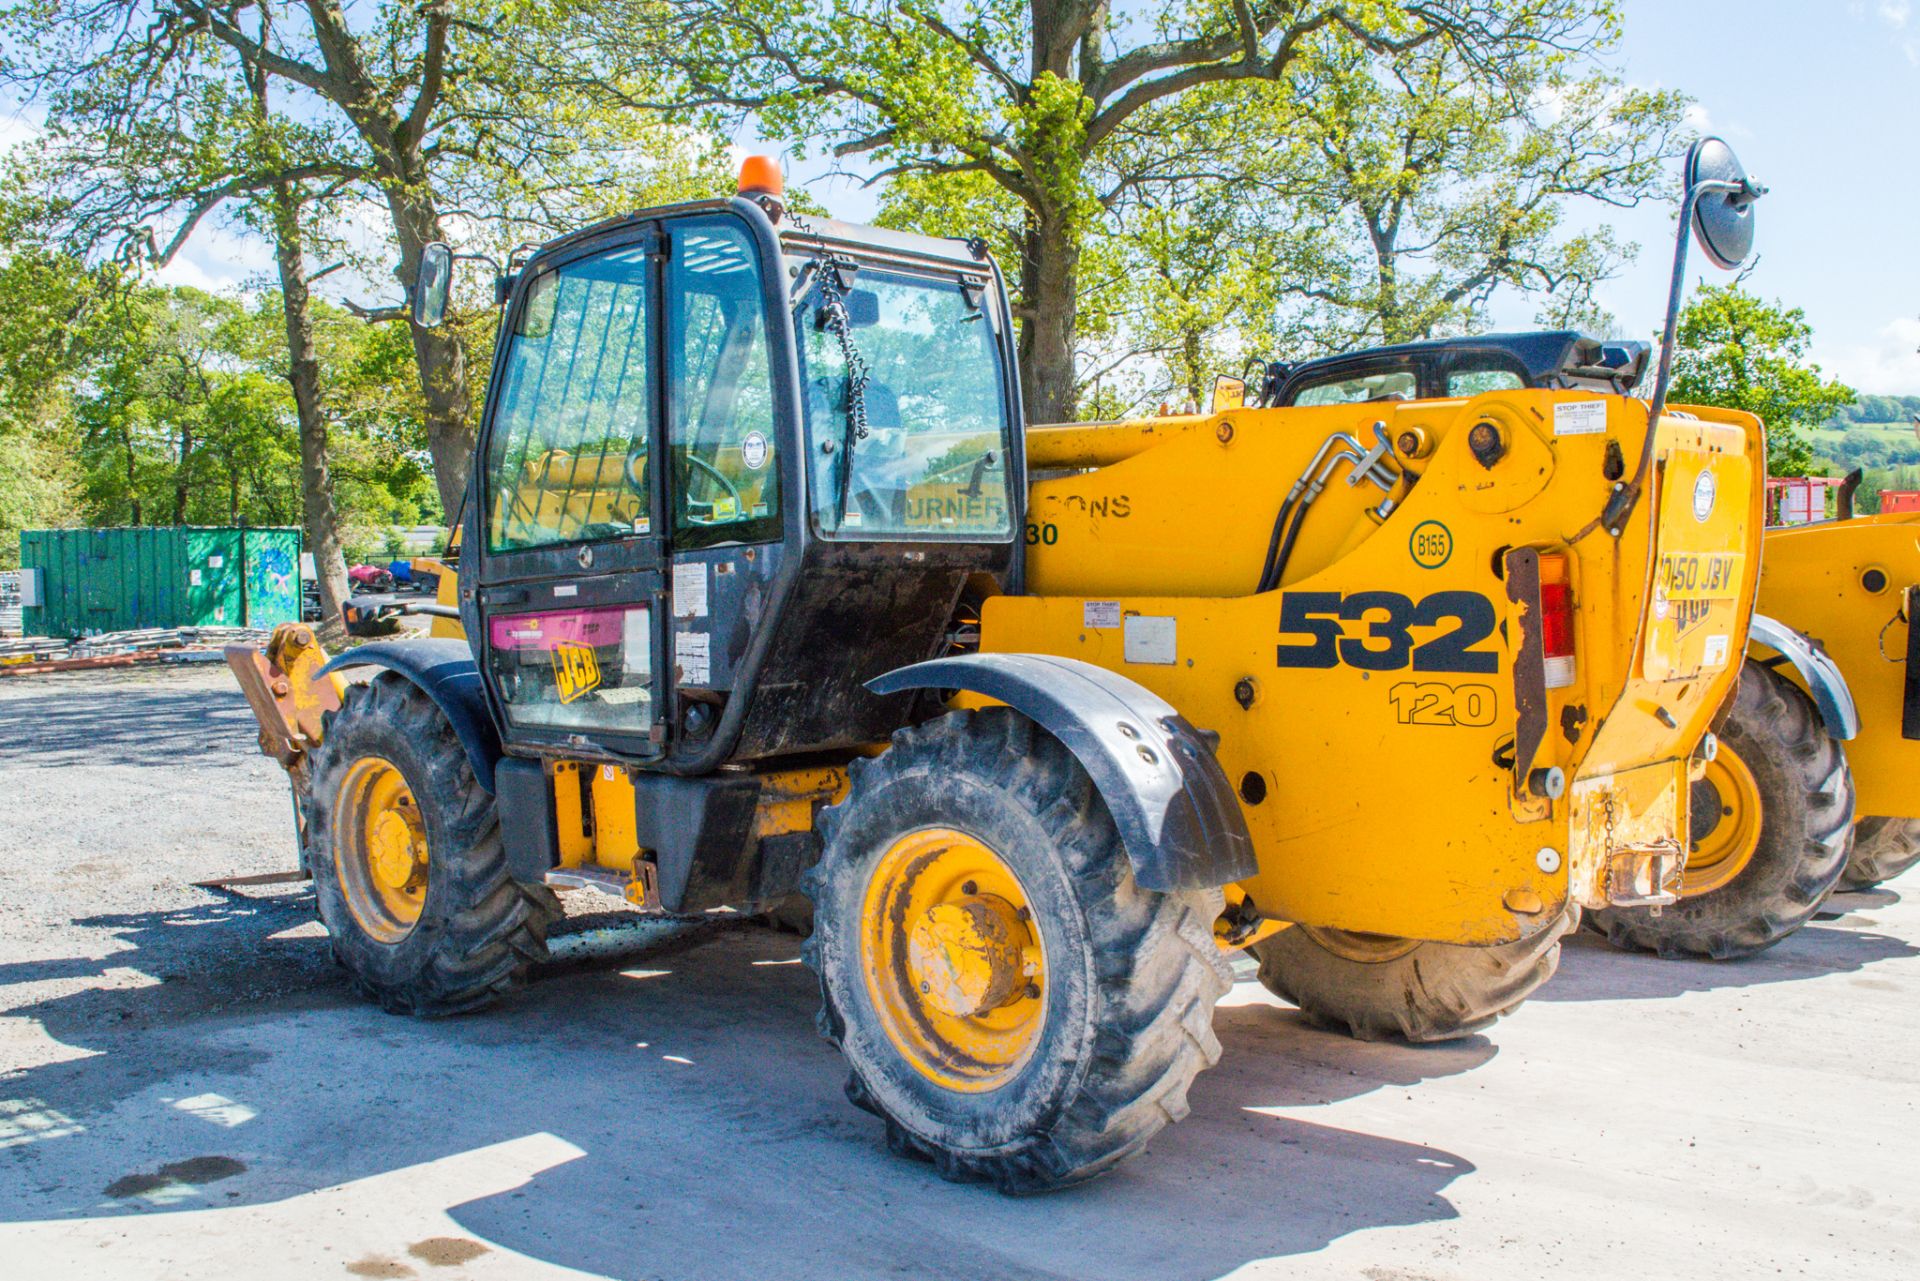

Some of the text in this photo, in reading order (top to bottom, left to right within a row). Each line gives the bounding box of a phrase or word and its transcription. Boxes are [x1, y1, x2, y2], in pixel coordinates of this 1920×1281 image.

[1418, 534, 1446, 557] B155
[1701, 557, 1734, 591] JBV
[1277, 590, 1499, 674] 532
[557, 644, 597, 698] JCB
[1389, 681, 1498, 727] 120
